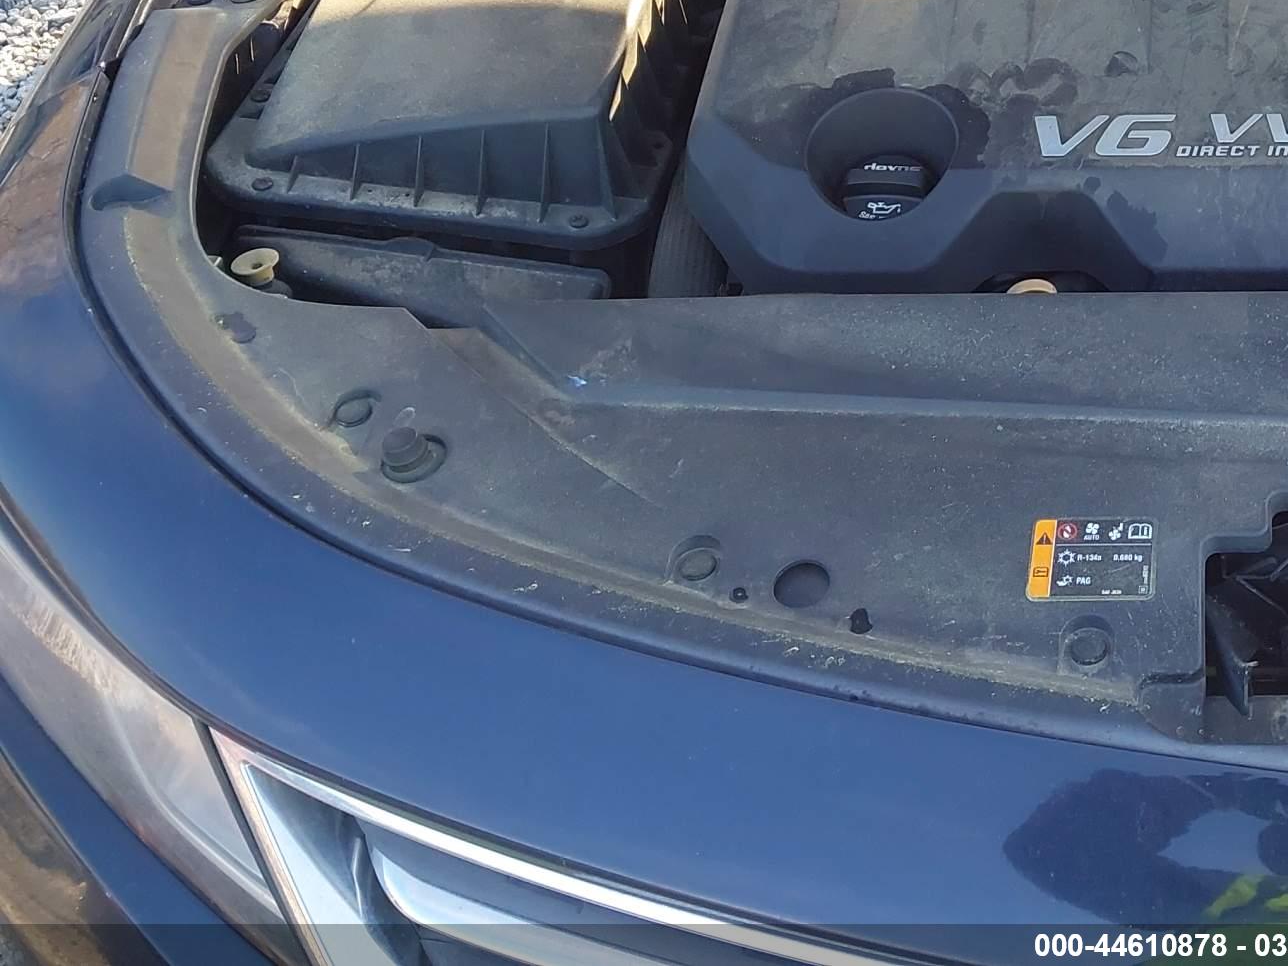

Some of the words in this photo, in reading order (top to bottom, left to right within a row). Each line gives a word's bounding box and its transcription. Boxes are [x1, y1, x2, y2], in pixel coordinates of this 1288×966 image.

[1034, 114, 1177, 157] V6
[1176, 145, 1260, 157] DIRECT
[1076, 577, 1091, 585] PAG
